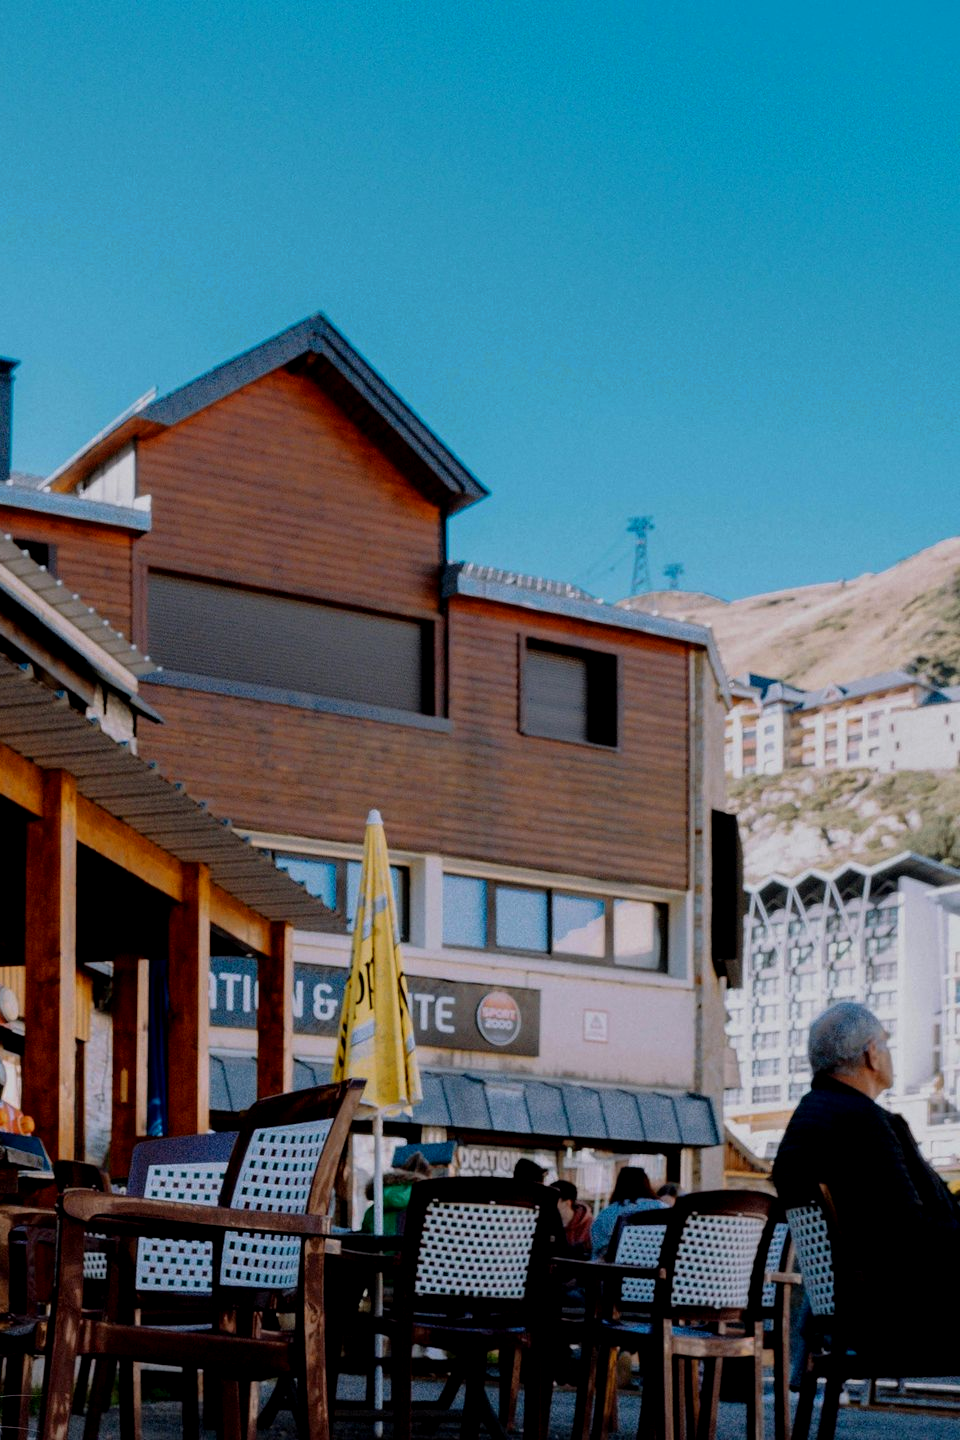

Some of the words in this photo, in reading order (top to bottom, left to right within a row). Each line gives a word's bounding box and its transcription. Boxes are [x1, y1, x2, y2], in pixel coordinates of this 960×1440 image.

[312, 982, 338, 1021] &
[481, 1006, 516, 1020] SPORT
[483, 1018, 513, 1031] 2000
